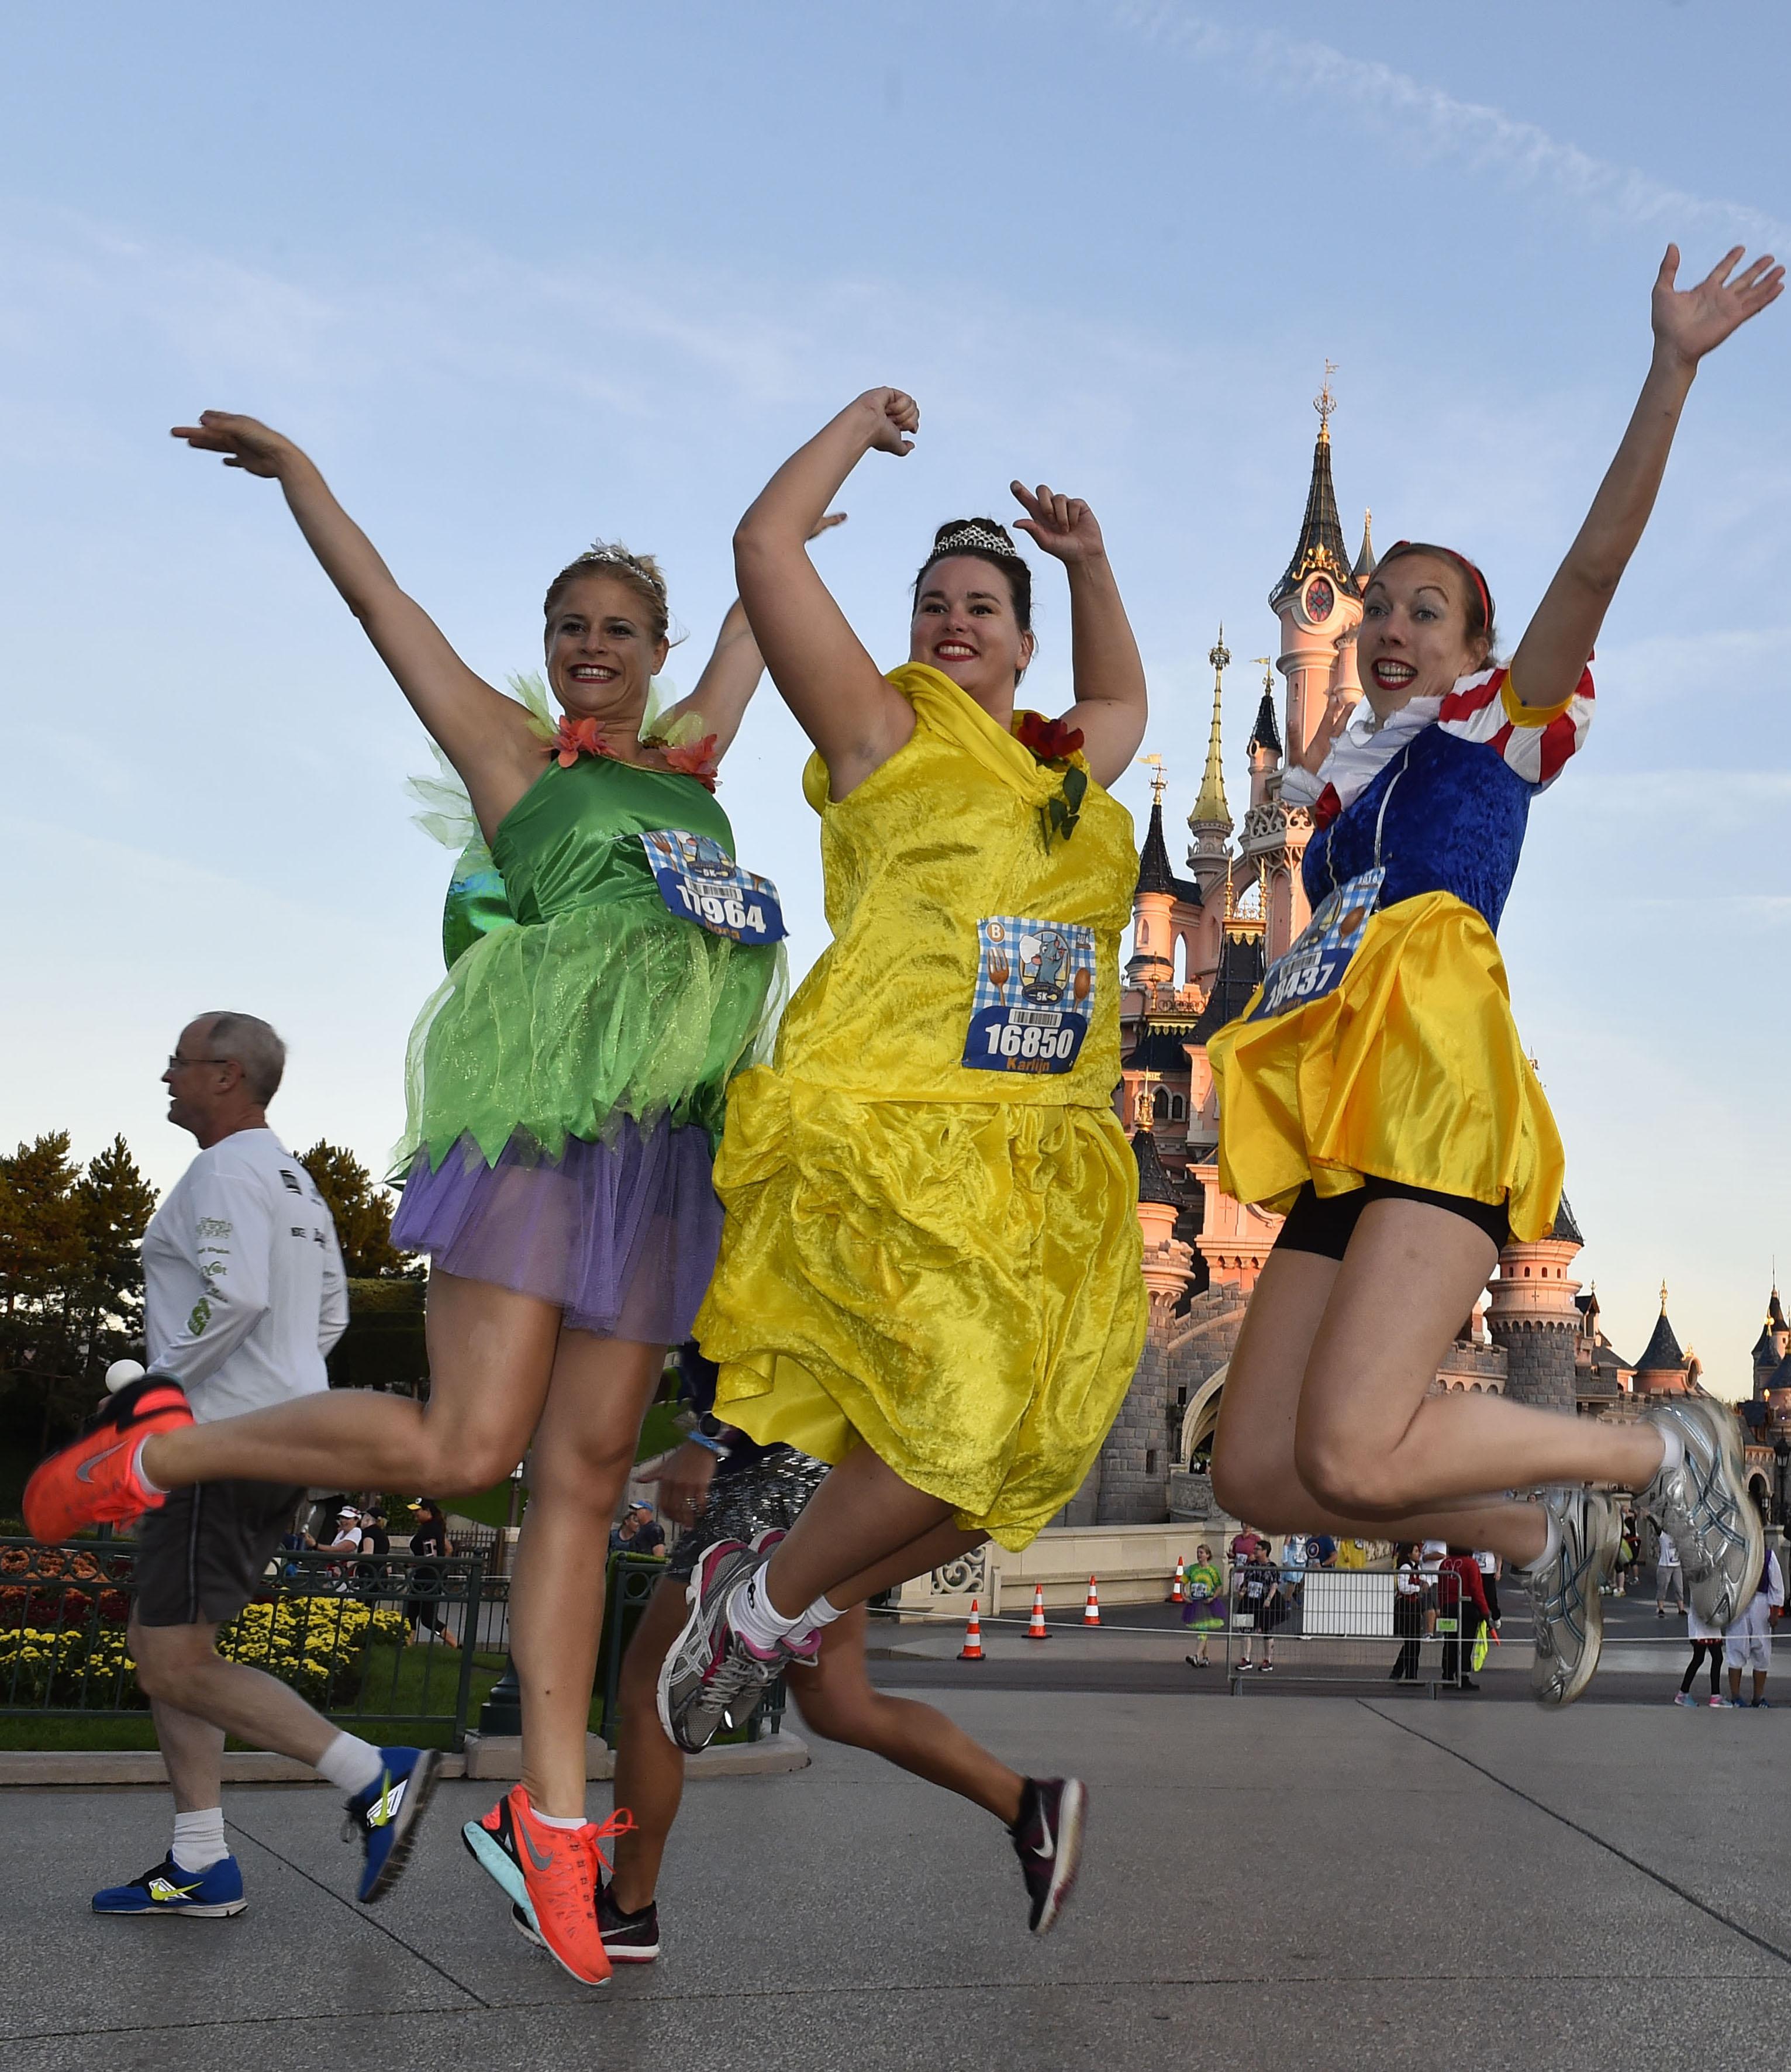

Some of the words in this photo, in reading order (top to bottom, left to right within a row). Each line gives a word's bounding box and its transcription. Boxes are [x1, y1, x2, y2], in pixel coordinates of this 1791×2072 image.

[676, 884, 767, 934] 11964
[991, 924, 1001, 939] B
[1036, 992, 1048, 1001] 5K
[1264, 962, 1336, 1013] 18437
[985, 1023, 1074, 1059] 16850
[1006, 1057, 1050, 1074] Karlijn
